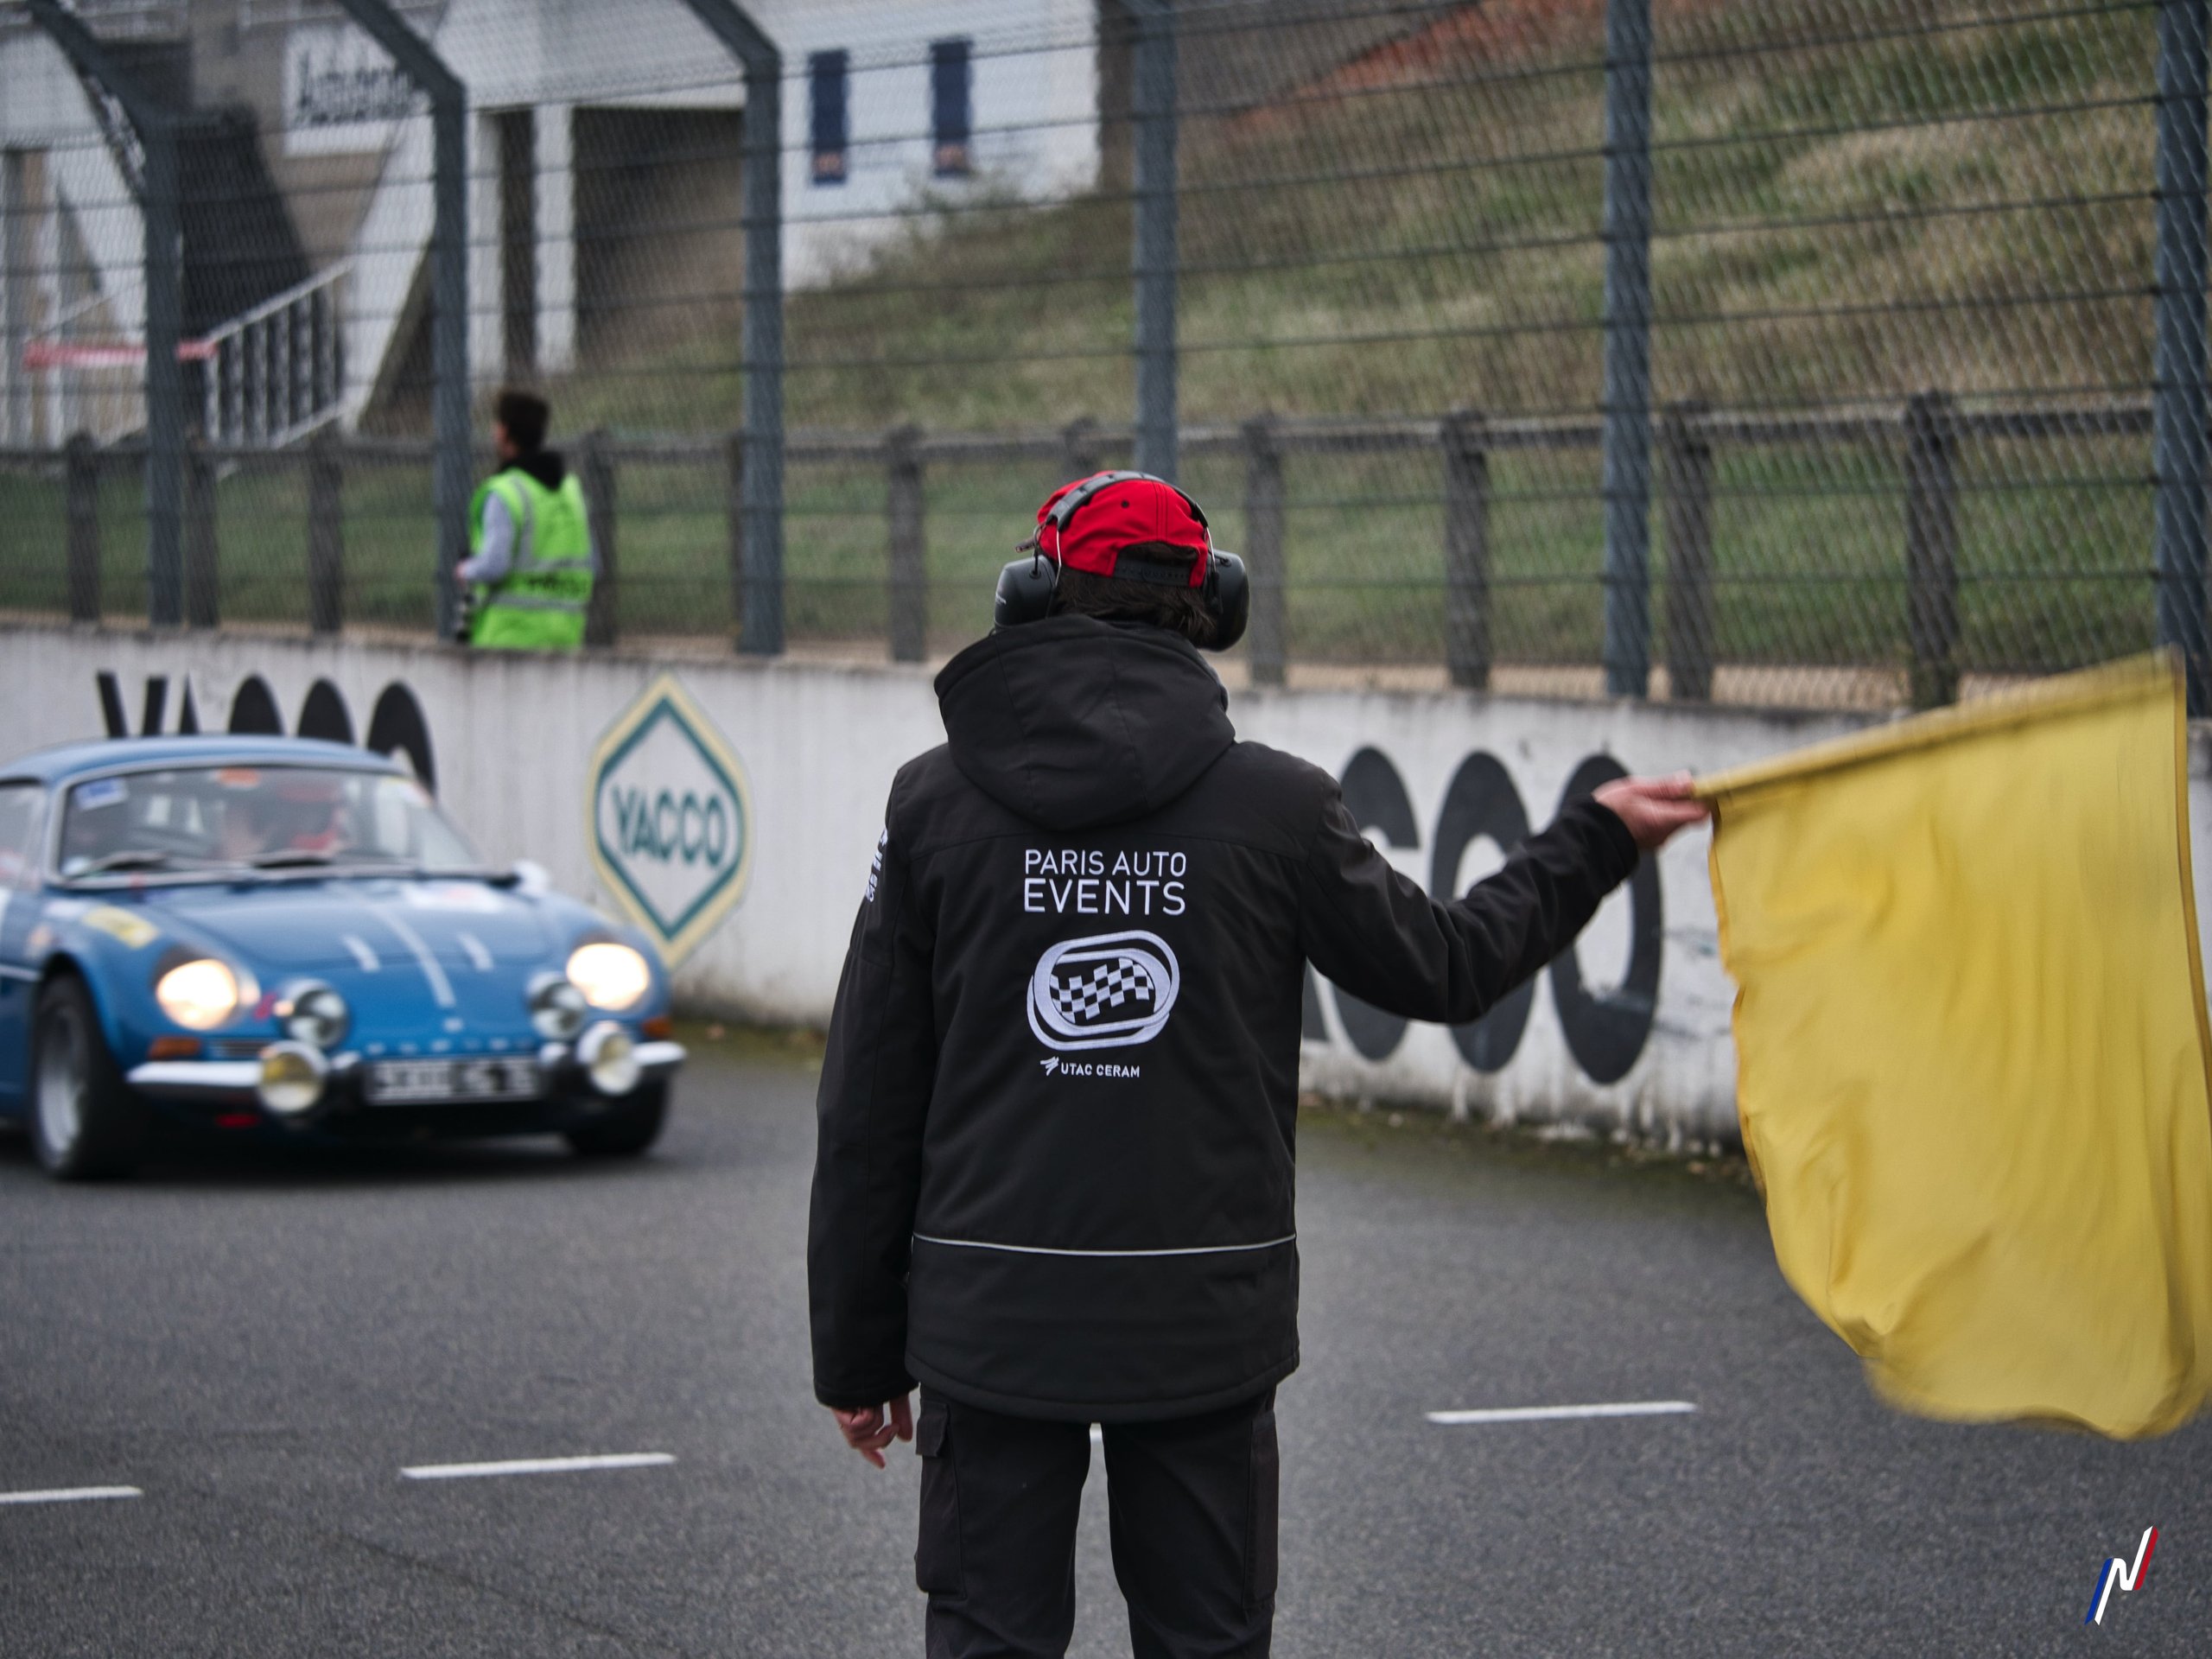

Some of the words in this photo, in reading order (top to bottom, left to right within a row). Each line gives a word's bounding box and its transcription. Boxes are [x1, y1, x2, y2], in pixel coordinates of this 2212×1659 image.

[612, 785, 728, 867] YACCO
[1025, 849, 1104, 875] PARIS
[1112, 849, 1186, 877] AUTO
[1024, 878, 1186, 916] EVENTS
[1061, 1062, 1093, 1076] UTAC
[1096, 1064, 1141, 1077] CERAM
